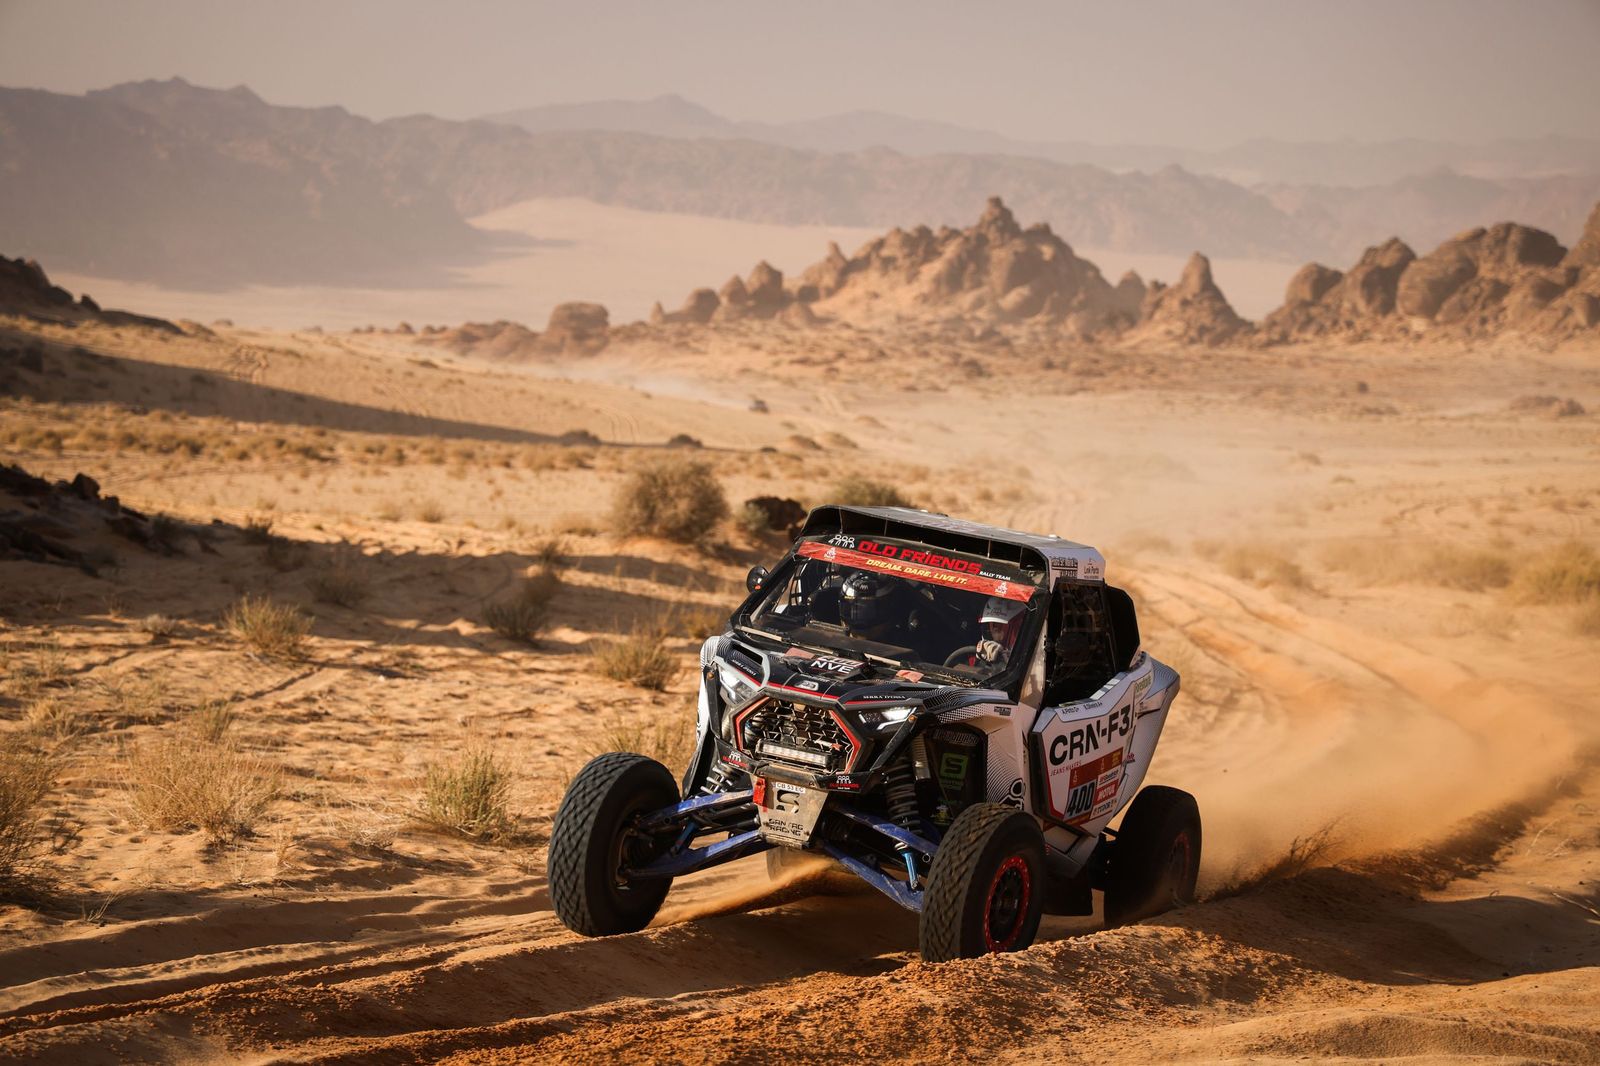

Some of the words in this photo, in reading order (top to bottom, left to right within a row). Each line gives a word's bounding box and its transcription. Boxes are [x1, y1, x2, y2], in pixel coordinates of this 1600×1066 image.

[857, 540, 898, 557] OLD
[899, 549, 983, 575] FRIENDS
[866, 559, 902, 571] DREAM.
[903, 567, 932, 578] DARE.
[933, 573, 955, 582] LIVE
[955, 577, 968, 585] IT.
[1049, 704, 1131, 766] CRN-F3
[1066, 781, 1095, 817] 400
